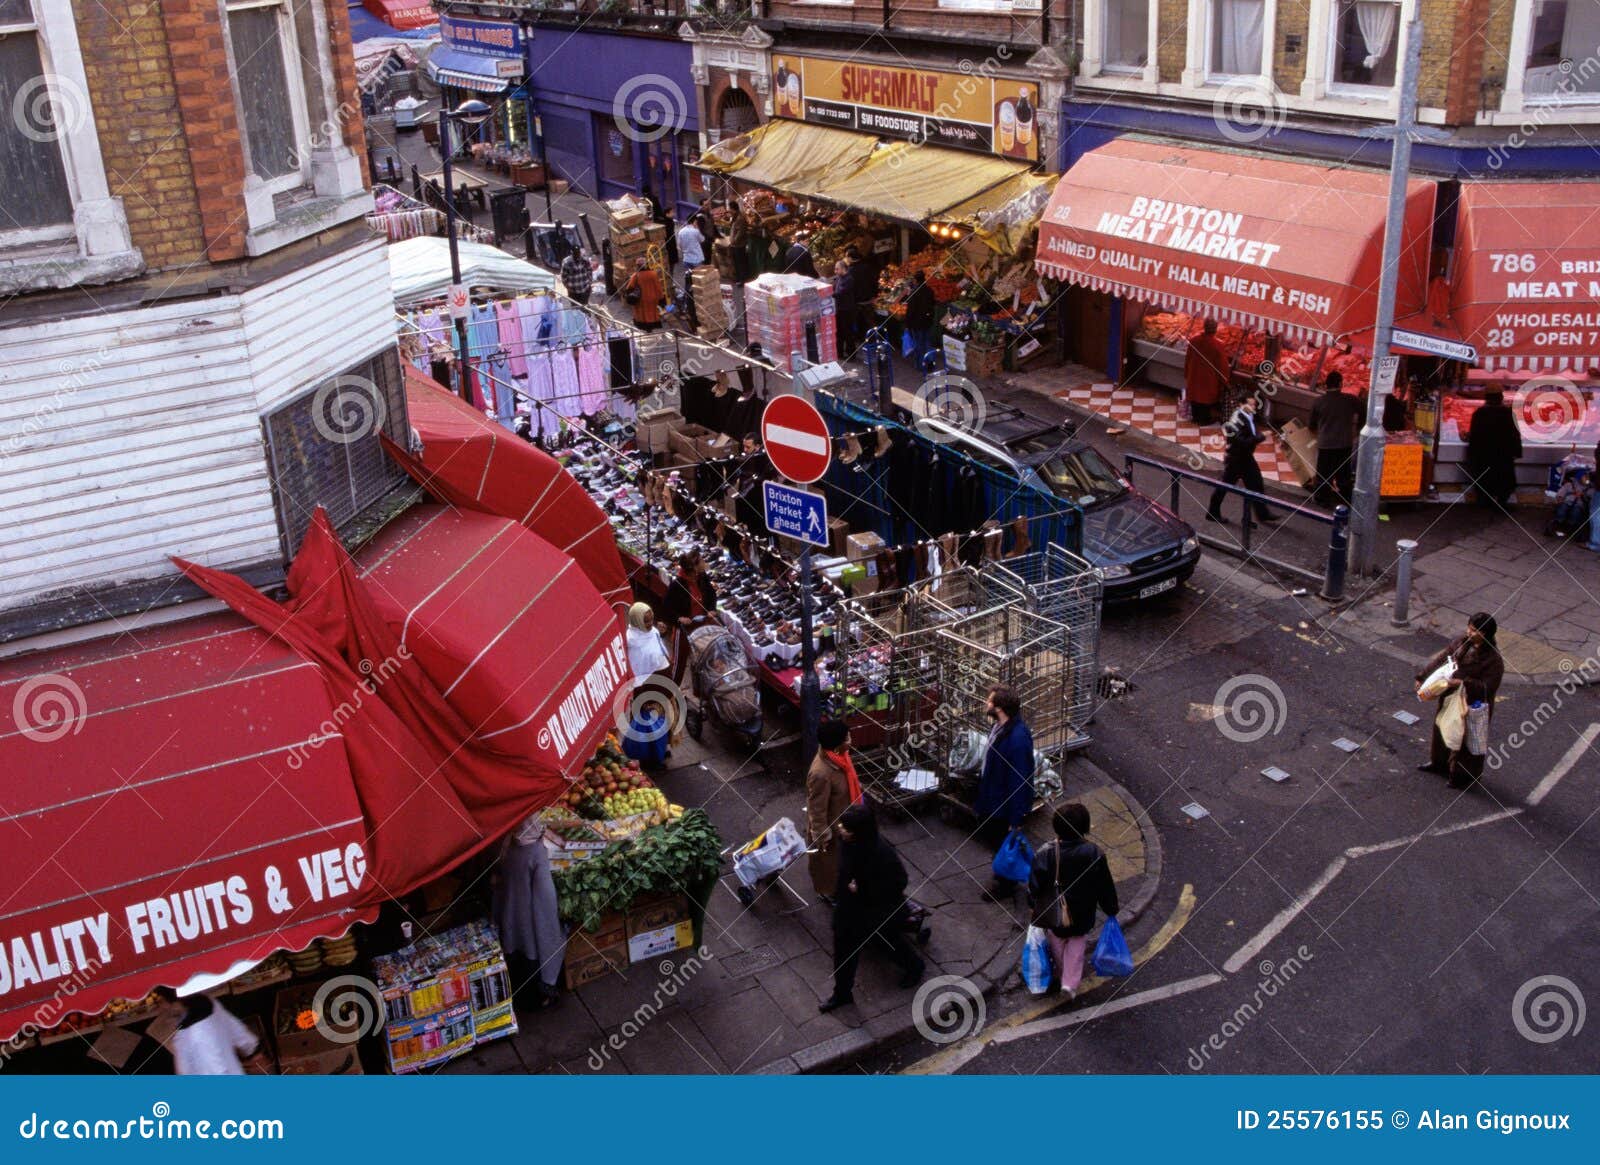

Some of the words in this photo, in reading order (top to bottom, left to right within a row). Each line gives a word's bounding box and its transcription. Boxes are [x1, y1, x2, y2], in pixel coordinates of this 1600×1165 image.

[841, 65, 938, 112] SUPERMALT
[861, 112, 873, 126] SW
[874, 114, 919, 133] FOODSTORE
[1128, 196, 1243, 236] BRIXTON
[1096, 211, 1166, 244] MEAT
[1166, 226, 1281, 268] MARKET
[1489, 253, 1536, 273] 786
[1047, 236, 1096, 260] AHMED
[1099, 250, 1163, 276] QUALITY
[1168, 264, 1220, 291] HALAL
[1222, 275, 1270, 300] MEAT
[1272, 286, 1285, 305] &
[1288, 288, 1332, 315] FISH
[1507, 281, 1578, 298] MEAT
[1496, 313, 1600, 328] WHOLESAL
[1486, 328, 1515, 348] 28
[1534, 331, 1583, 346] OPEN
[1588, 332, 1598, 346] 7
[1380, 358, 1397, 368] CCTV
[768, 487, 802, 507] Brixton
[769, 501, 803, 520] Market
[773, 516, 801, 531] ahead
[559, 679, 593, 745] QUALITY
[584, 653, 614, 712] FRUITS
[125, 875, 253, 954] FRUITS
[264, 865, 293, 914] &
[297, 842, 367, 902] VEG
